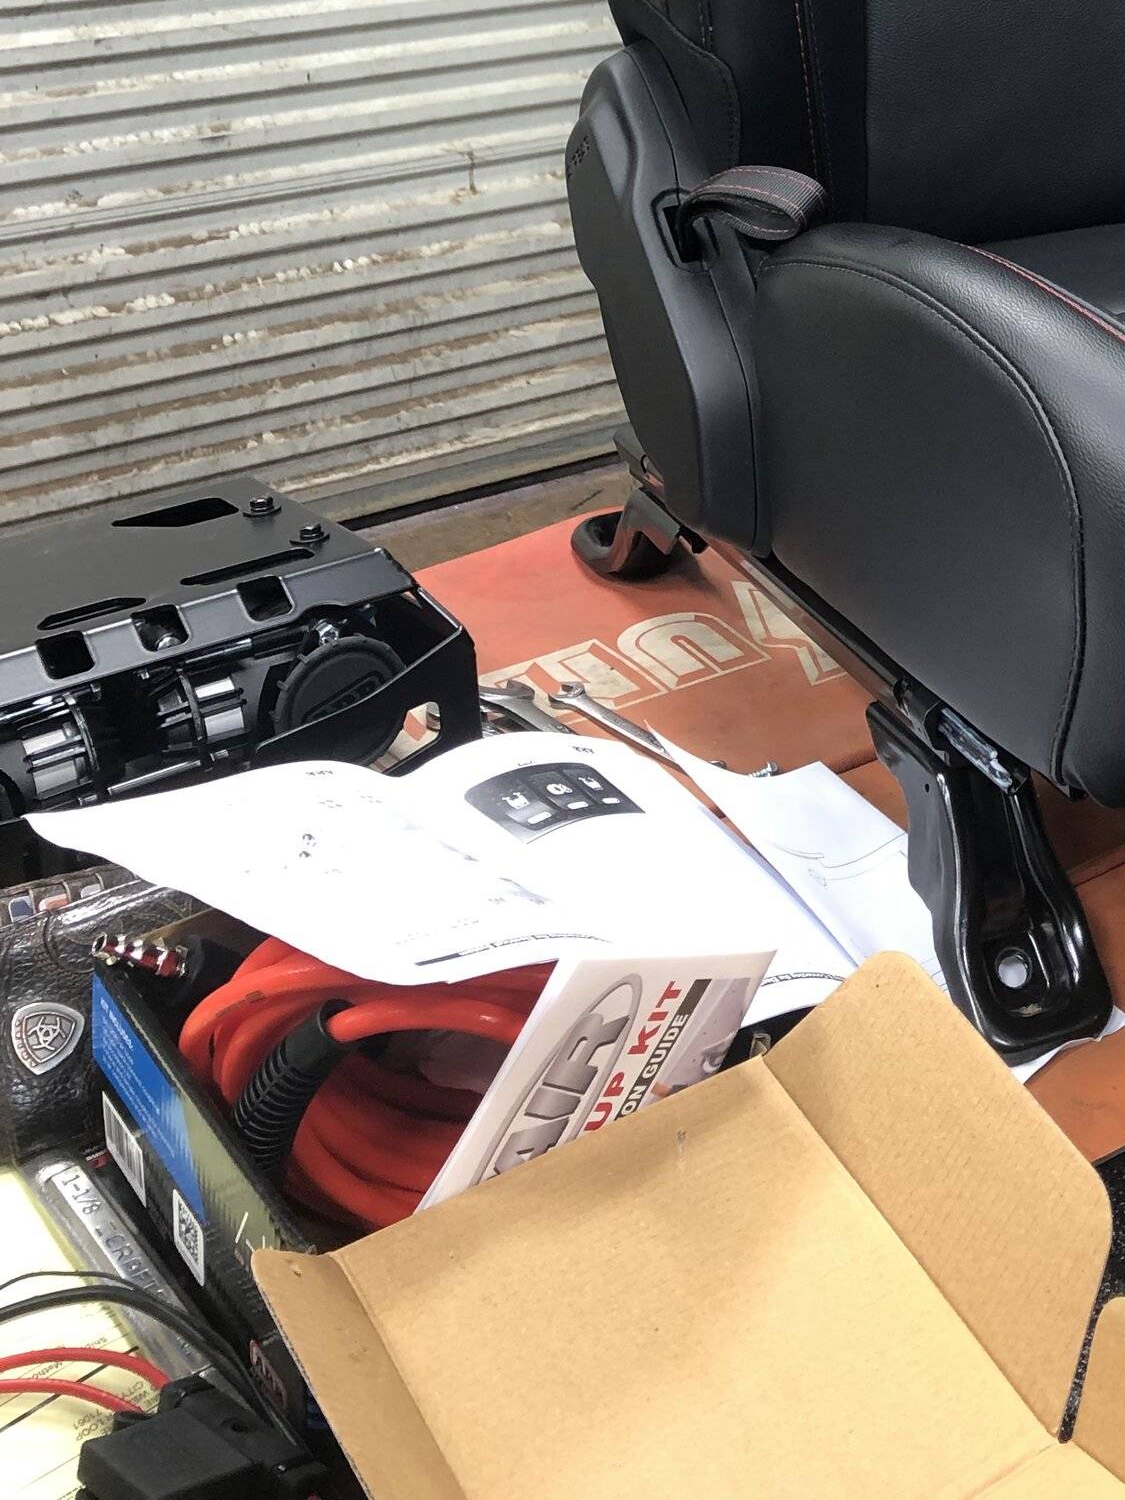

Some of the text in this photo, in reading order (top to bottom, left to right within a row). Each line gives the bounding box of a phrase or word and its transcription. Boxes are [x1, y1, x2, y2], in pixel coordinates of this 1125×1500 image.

[584, 981, 683, 1132] UP KIT
[642, 1013, 690, 1079] GUIDE
[61, 1174, 102, 1216] 1-1/8
